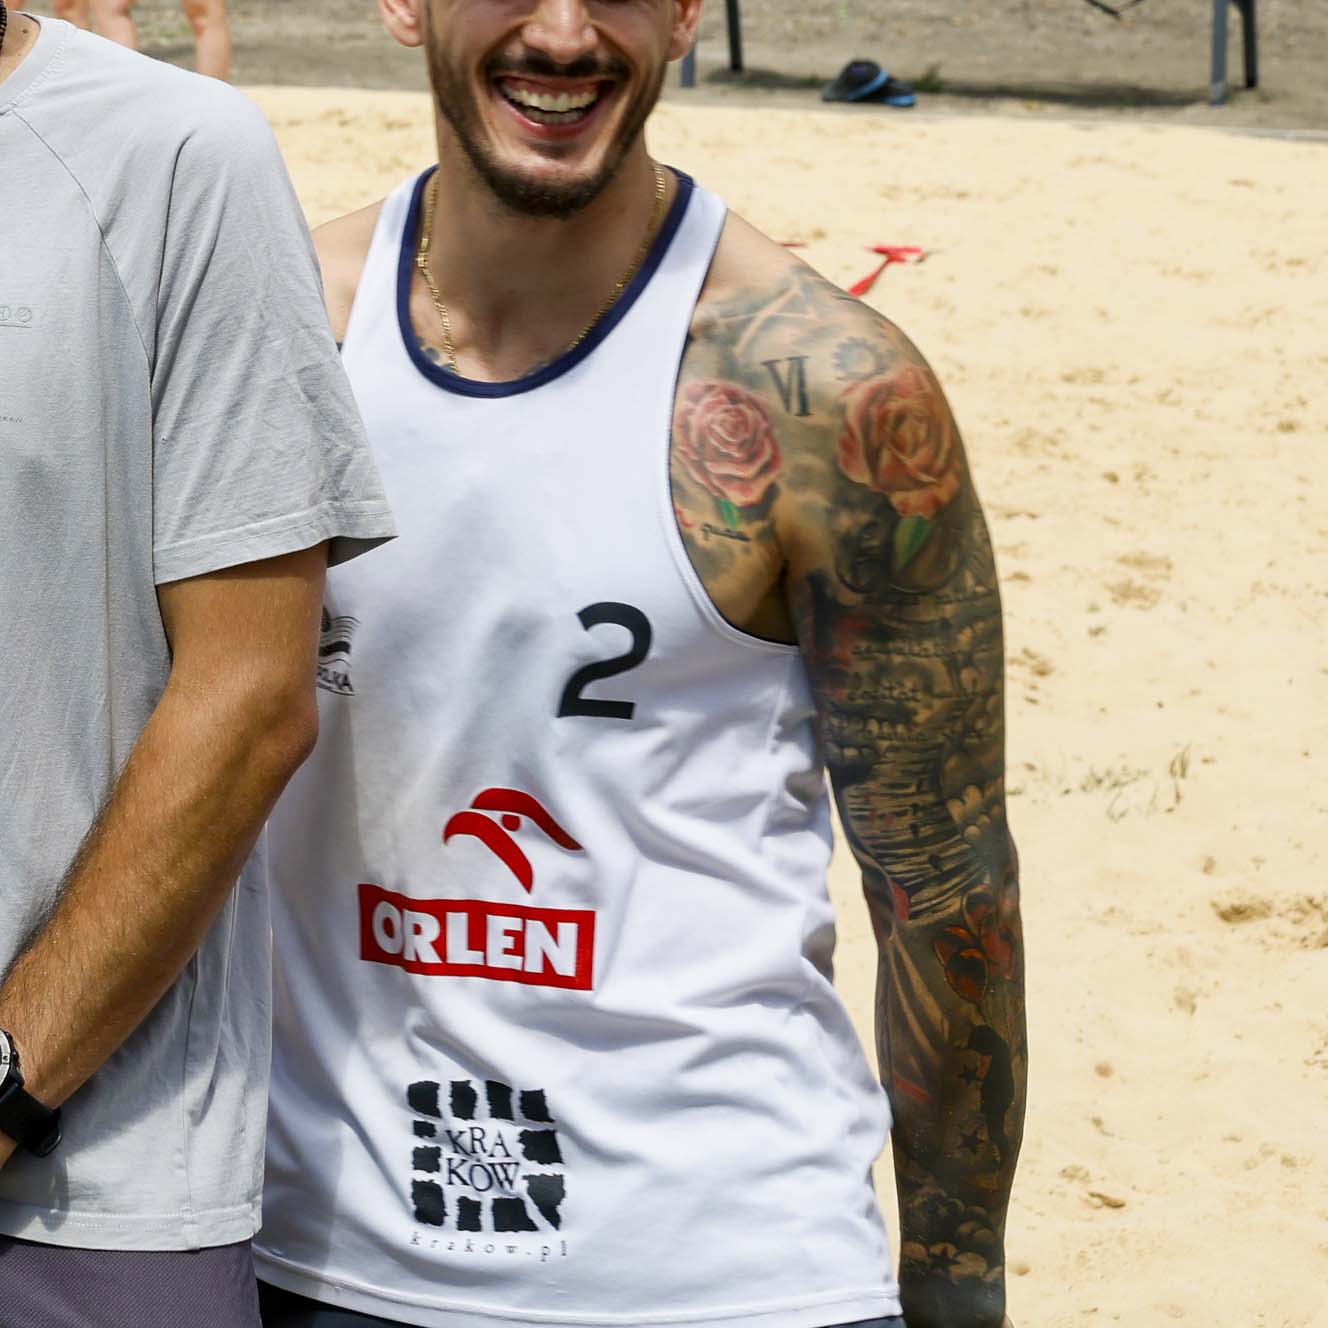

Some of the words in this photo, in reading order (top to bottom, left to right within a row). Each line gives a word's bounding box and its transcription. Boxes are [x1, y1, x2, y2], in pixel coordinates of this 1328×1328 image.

[557, 601, 653, 720] 2
[372, 900, 579, 978] ORLEN
[445, 1126, 512, 1157] KRA
